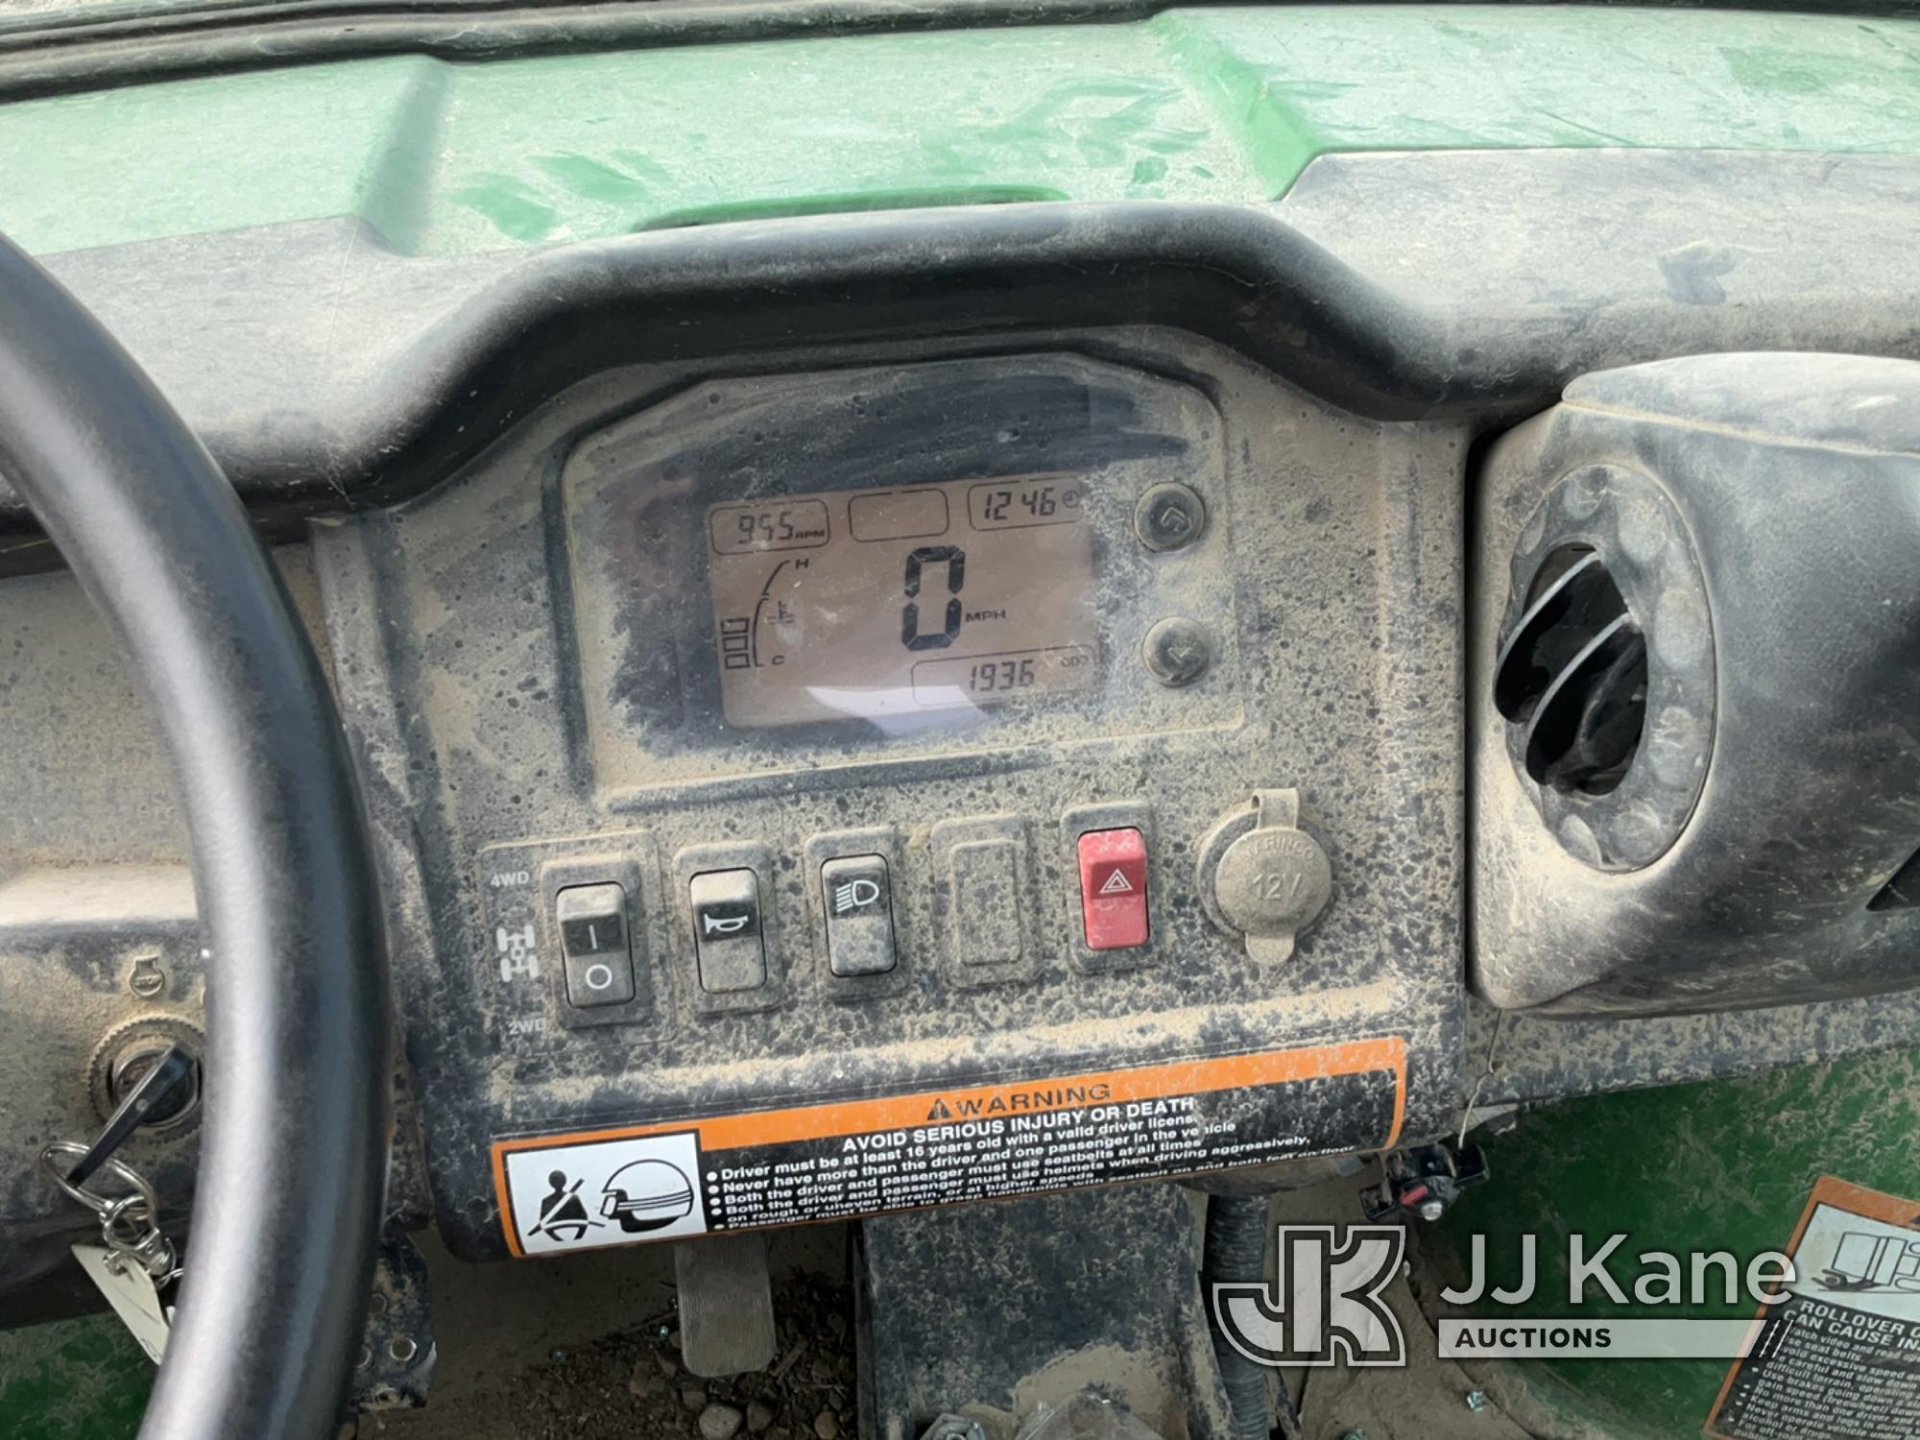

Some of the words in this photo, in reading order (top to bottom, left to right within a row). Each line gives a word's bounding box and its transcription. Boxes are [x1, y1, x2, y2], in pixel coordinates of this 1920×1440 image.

[738, 511, 794, 544] 955
[901, 544, 966, 652] 0
[965, 608, 1007, 622] MPH
[970, 659, 1035, 692] 1936
[490, 870, 530, 887] 4WD
[956, 1084, 1110, 1116] WARNING
[721, 1166, 770, 1180] Driver
[775, 1159, 815, 1173] must
[819, 1157, 839, 1169] be
[844, 1154, 859, 1166] at
[863, 1149, 902, 1164] least
[907, 1146, 924, 1158] 16
[929, 1142, 972, 1157] years
[976, 1136, 1001, 1149] old
[1006, 1132, 1039, 1146] with
[1043, 1132, 1052, 1141] a
[1057, 1125, 1094, 1139] valid
[1098, 1120, 1144, 1135] driver
[1148, 1114, 1198, 1129] licens
[842, 1131, 907, 1153] AVOID
[913, 1119, 1005, 1144] SERIOUS
[1011, 1110, 1084, 1132] INJURY
[1090, 1106, 1120, 1122] OR
[1126, 1096, 1194, 1118] DEATH
[723, 1179, 770, 1193] Never
[774, 1174, 813, 1187] have
[817, 1169, 858, 1181] more
[863, 1163, 897, 1176] than
[901, 1160, 927, 1172] the
[931, 1154, 977, 1168] driver
[981, 1149, 1010, 1162] and
[1015, 1146, 1044, 1157] one
[1049, 1135, 1130, 1155] passenger
[1134, 1133, 1149, 1143] in
[1152, 1129, 1177, 1141] the
[724, 1192, 762, 1205] Both
[767, 1189, 792, 1201] the
[797, 1183, 843, 1196] driver
[848, 1178, 877, 1190] and
[881, 1168, 964, 1187] passenger
[968, 1162, 1007, 1174] must
[1012, 1160, 1040, 1170] use
[1044, 1149, 1114, 1166] seatbelts
[1118, 1146, 1133, 1157] at
[1137, 1143, 1156, 1154] all
[1160, 1140, 1201, 1152] times
[726, 1202, 763, 1215] Both
[768, 1199, 793, 1209] the
[798, 1193, 844, 1206] driver
[848, 1189, 878, 1200] and
[882, 1180, 964, 1197] passenger
[968, 1173, 1007, 1184] must
[1012, 1170, 1040, 1180] use
[1044, 1161, 1105, 1176] helmets
[1109, 1157, 1149, 1169] when
[1154, 1148, 1207, 1162] driving
[727, 1214, 747, 1223] on
[752, 1207, 799, 1220] rough
[803, 1206, 820, 1214] or
[825, 1197, 881, 1211] uneven
[946, 1188, 962, 1196] or
[967, 1185, 981, 1194] at
[986, 1180, 1035, 1192] higher
[1039, 1172, 1094, 1185] speeds
[1783, 1309, 1824, 1329] CAN
[1828, 1322, 1893, 1346] CAUSE
[1897, 1337, 1920, 1351] IN
[1800, 1300, 1905, 1335] ROLLOVER
